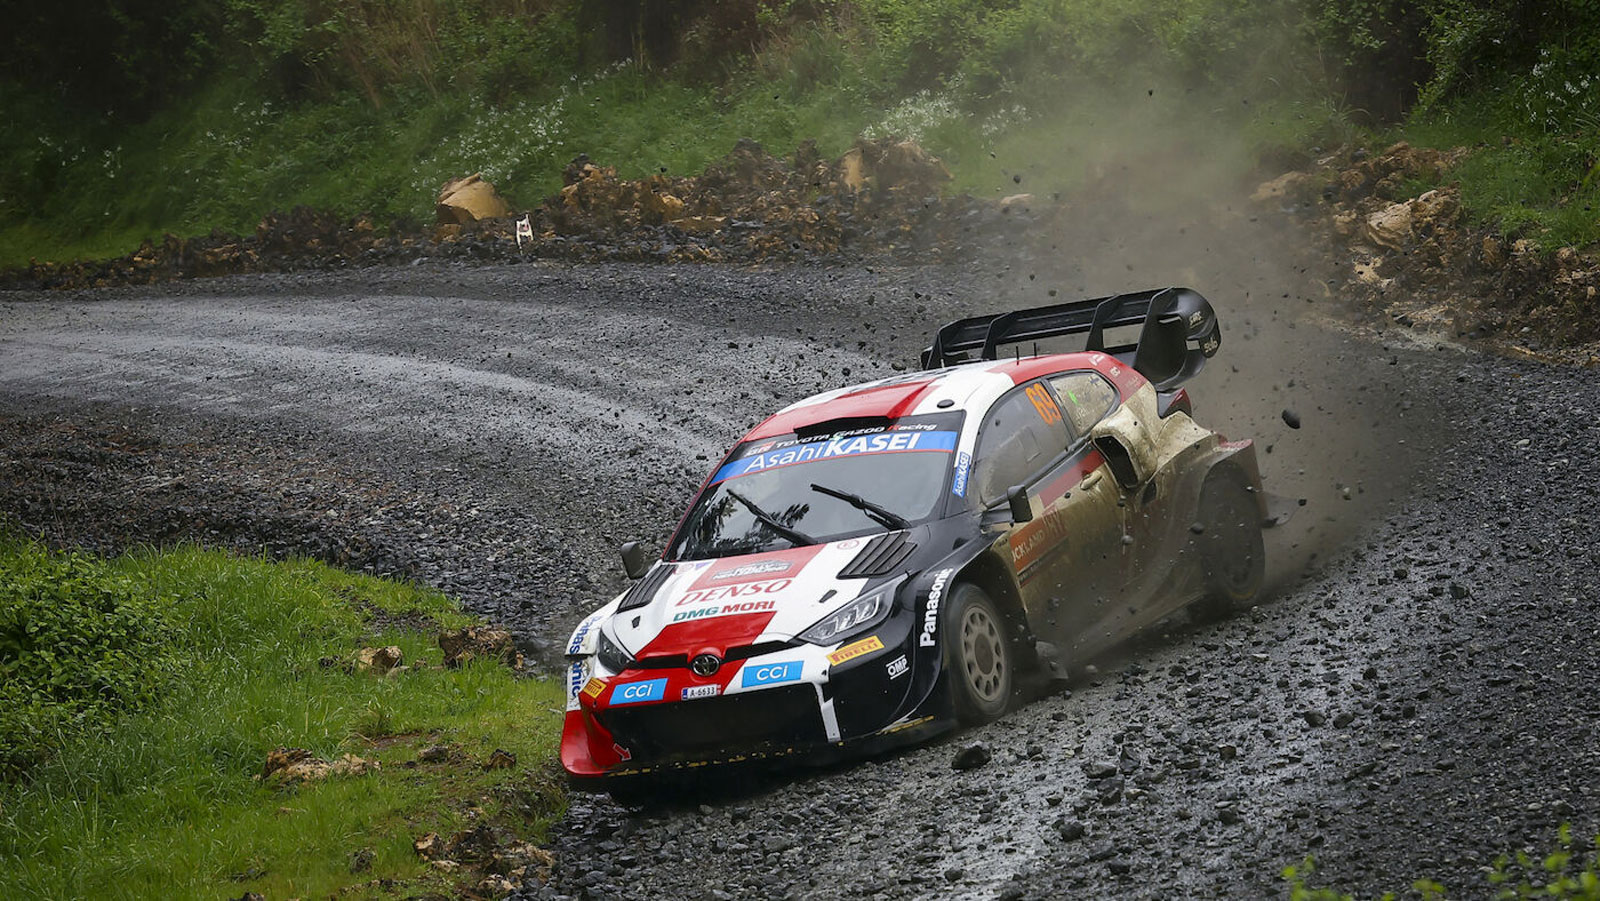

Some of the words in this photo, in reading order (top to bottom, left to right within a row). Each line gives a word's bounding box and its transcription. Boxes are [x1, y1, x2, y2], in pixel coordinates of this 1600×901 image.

[1025, 383, 1061, 427] 69
[776, 433, 831, 448] TOYOTA
[833, 426, 885, 438] GAZOO
[675, 579, 792, 607] DENSO
[673, 607, 719, 622] DMG
[720, 600, 776, 615] MORI
[919, 568, 954, 647] Panasonic
[831, 640, 879, 662] PIRELLI
[887, 658, 907, 676] OMP
